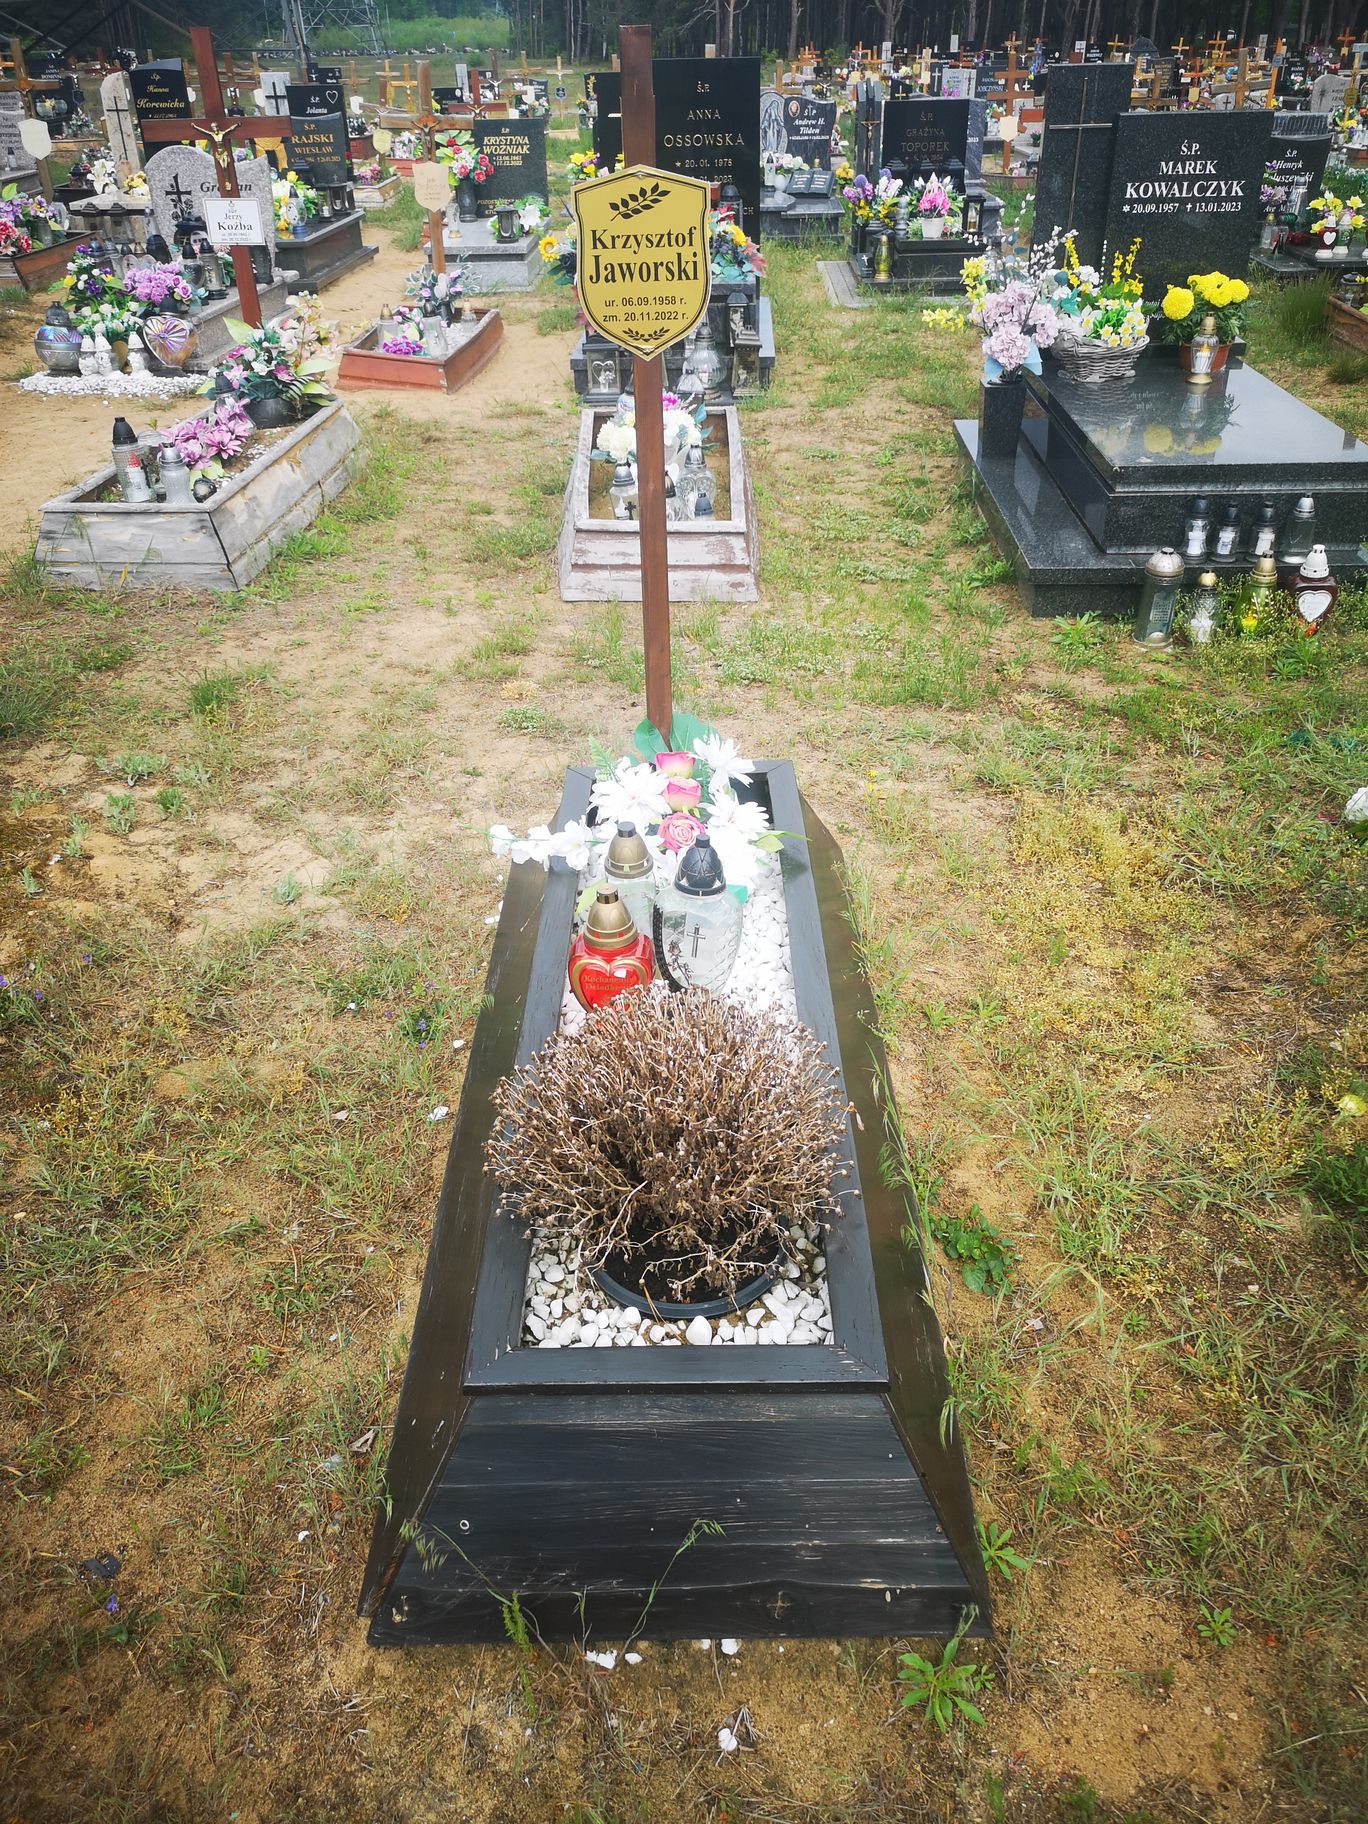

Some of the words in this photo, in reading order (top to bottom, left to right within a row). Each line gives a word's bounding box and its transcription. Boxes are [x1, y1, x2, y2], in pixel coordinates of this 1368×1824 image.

[687, 109, 721, 120] ANNA
[793, 118, 817, 126] Andrew
[905, 127, 945, 137] GRAŻYNA
[291, 134, 335, 144] RAJSKI
[483, 136, 530, 145] KRYSTYNA
[664, 133, 745, 147] OSSOWSKA
[483, 145, 530, 154] WOŹNIAK
[901, 141, 951, 151] TOPOREK
[1180, 140, 1201, 155] Ś.P.
[1159, 160, 1218, 175] MAREK
[1275, 160, 1304, 171] Henryk
[1125, 180, 1246, 198] KOWALCZYK
[1132, 203, 1180, 213] 20.09.1957
[1195, 202, 1242, 212] 13.01.2023
[590, 226, 697, 254] Krzysztof
[589, 251, 700, 284] Jaworski
[604, 299, 619, 307] ur.
[621, 296, 677, 306] 06.09.1958
[679, 297, 687, 305] r.
[602, 314, 621, 322] zm.
[624, 311, 679, 321] 20.11.2022
